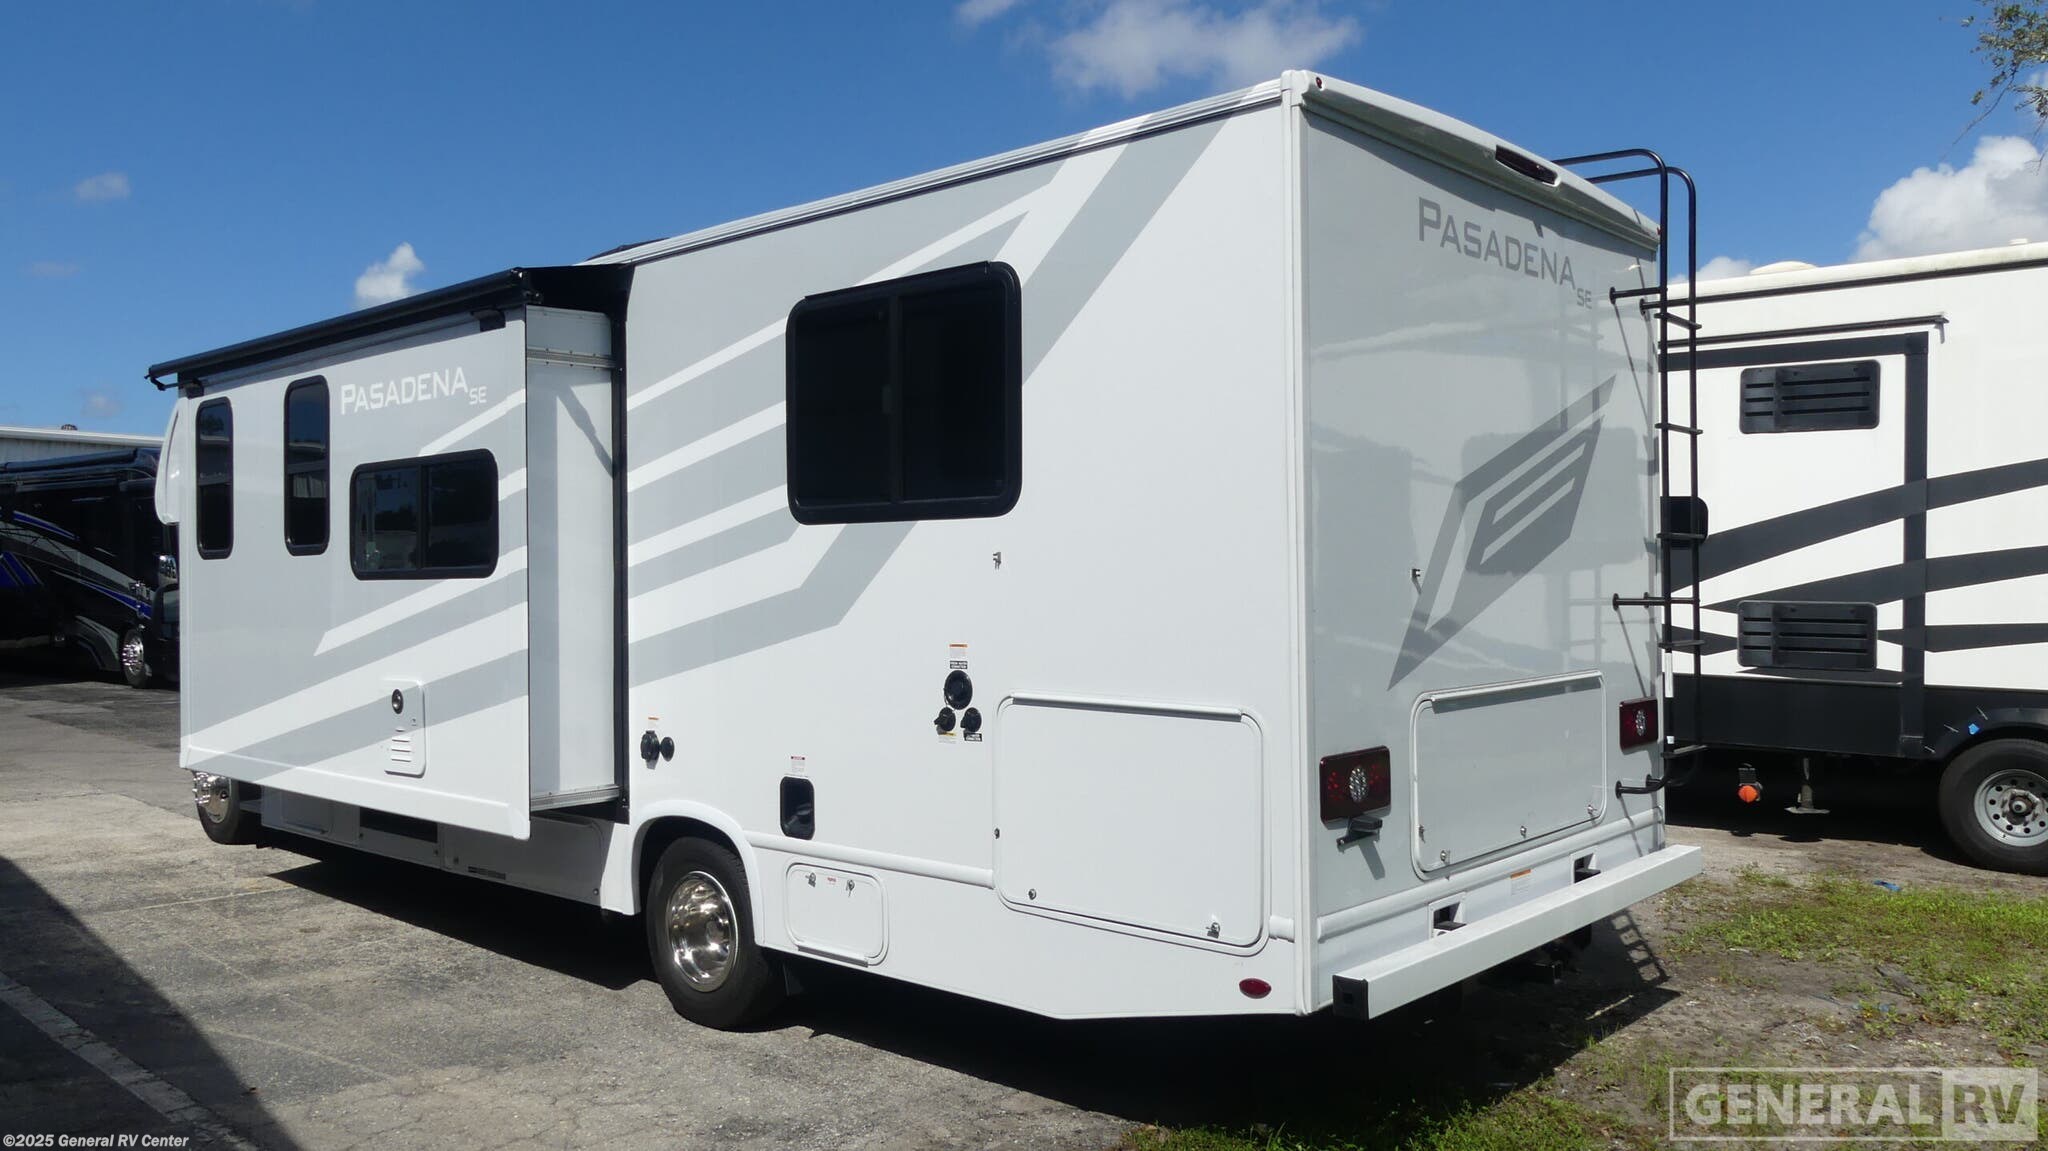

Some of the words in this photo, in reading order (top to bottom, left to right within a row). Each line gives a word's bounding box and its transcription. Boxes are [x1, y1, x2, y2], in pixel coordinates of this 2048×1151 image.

[1419, 197, 1576, 290] PASADENA
[1577, 288, 1592, 309] SE
[341, 366, 468, 415] PASADENA
[469, 386, 487, 405] SE
